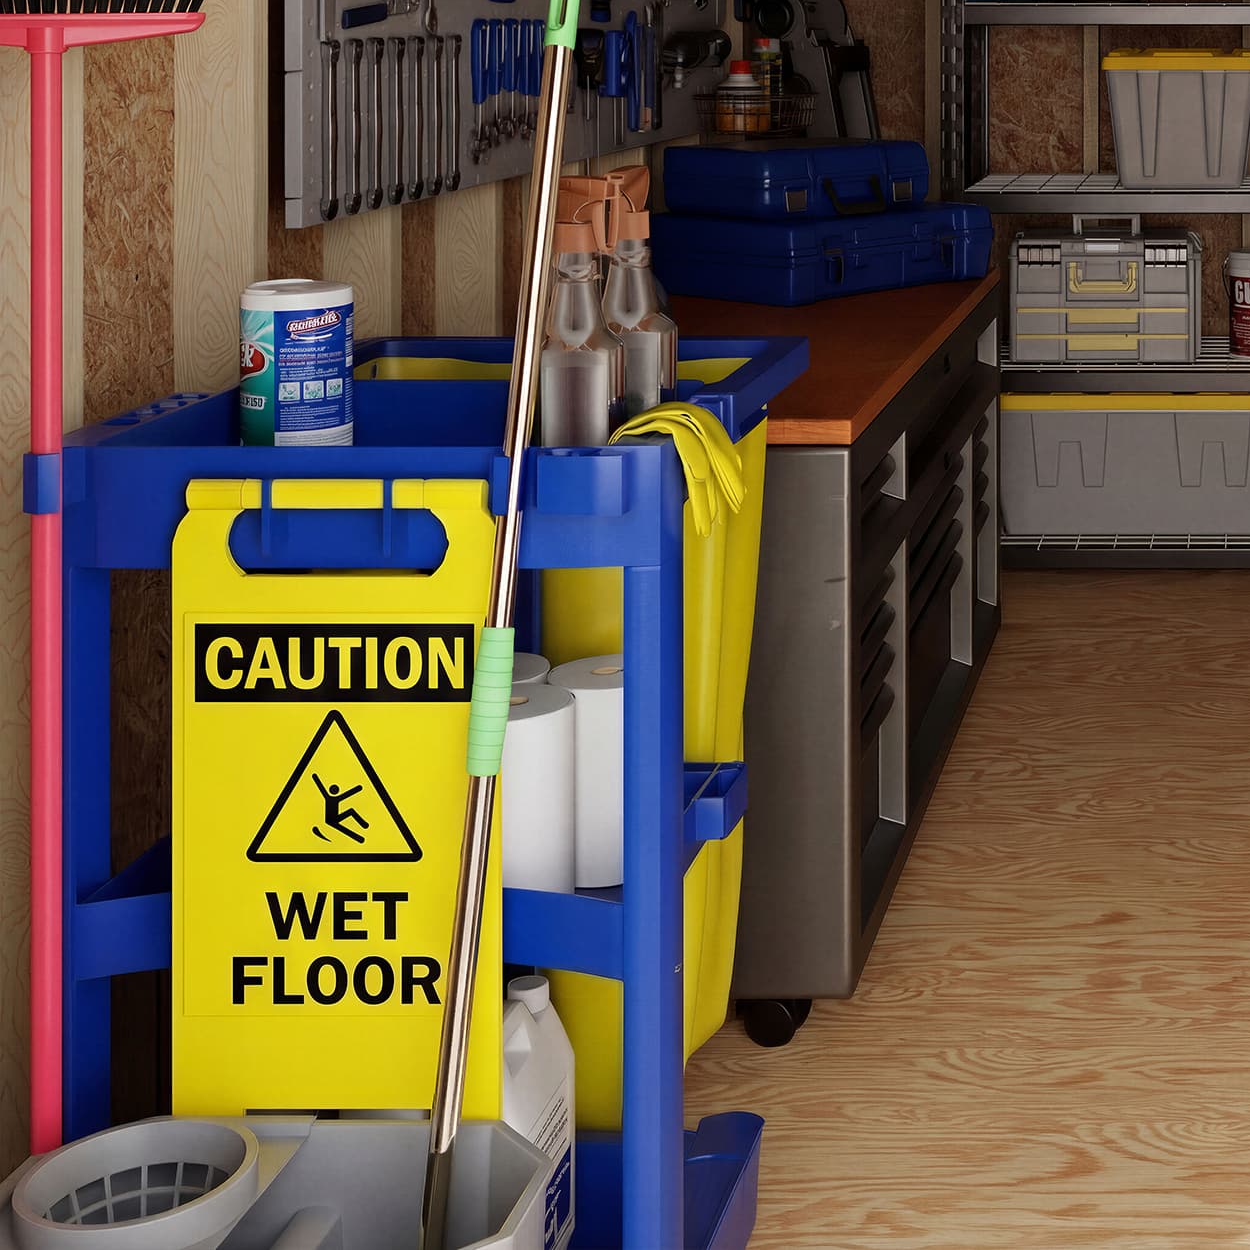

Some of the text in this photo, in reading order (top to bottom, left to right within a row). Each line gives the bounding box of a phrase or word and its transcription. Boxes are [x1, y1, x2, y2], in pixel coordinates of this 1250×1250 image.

[205, 636, 466, 690] CAUTION
[265, 891, 409, 941] WET
[232, 955, 442, 1005] FLOOR
